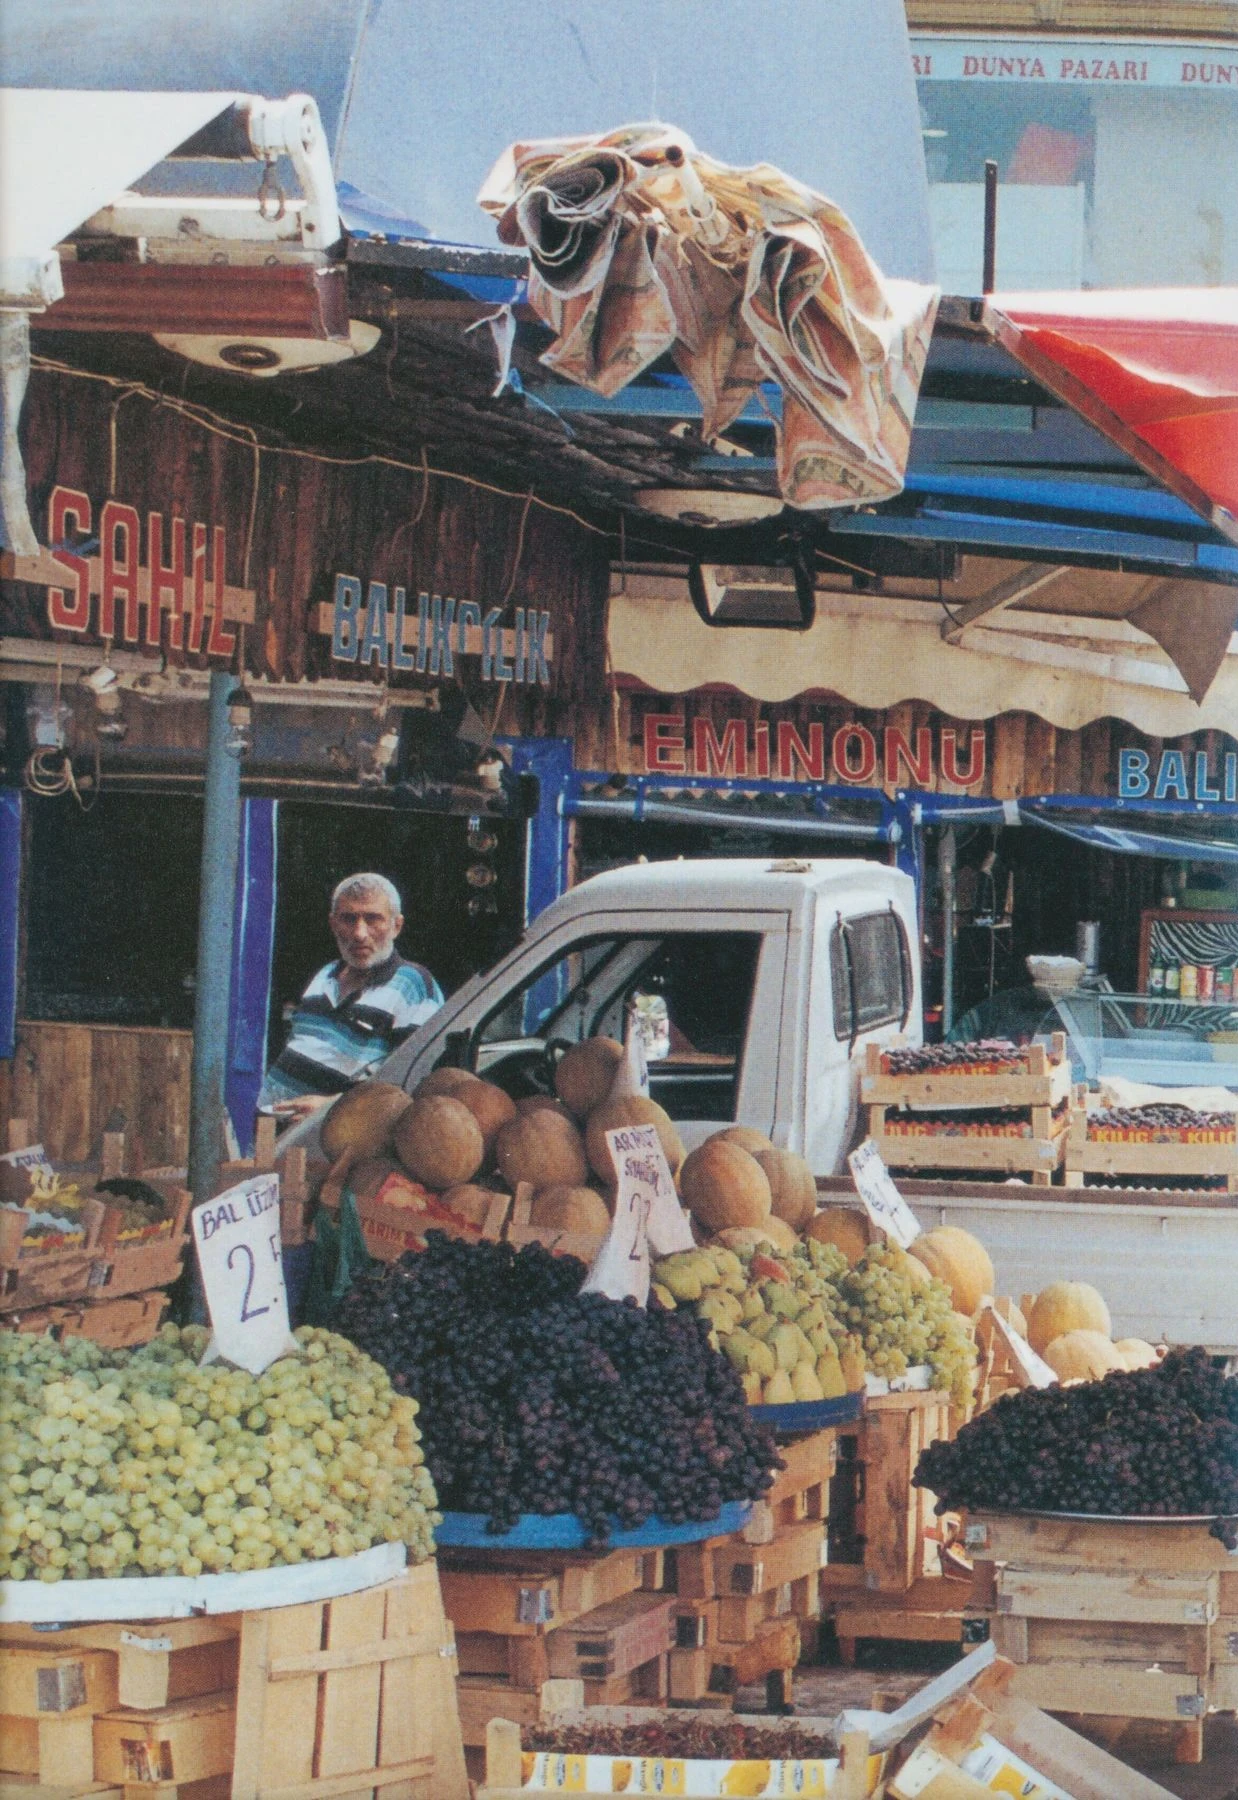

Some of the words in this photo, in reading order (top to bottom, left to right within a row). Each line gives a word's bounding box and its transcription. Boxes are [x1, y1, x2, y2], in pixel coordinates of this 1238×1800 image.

[1059, 58, 1148, 81] PAZARI
[643, 713, 986, 788] EMİNÖNÜ
[201, 1203, 243, 1240] BAL
[227, 1244, 270, 1322] 2
